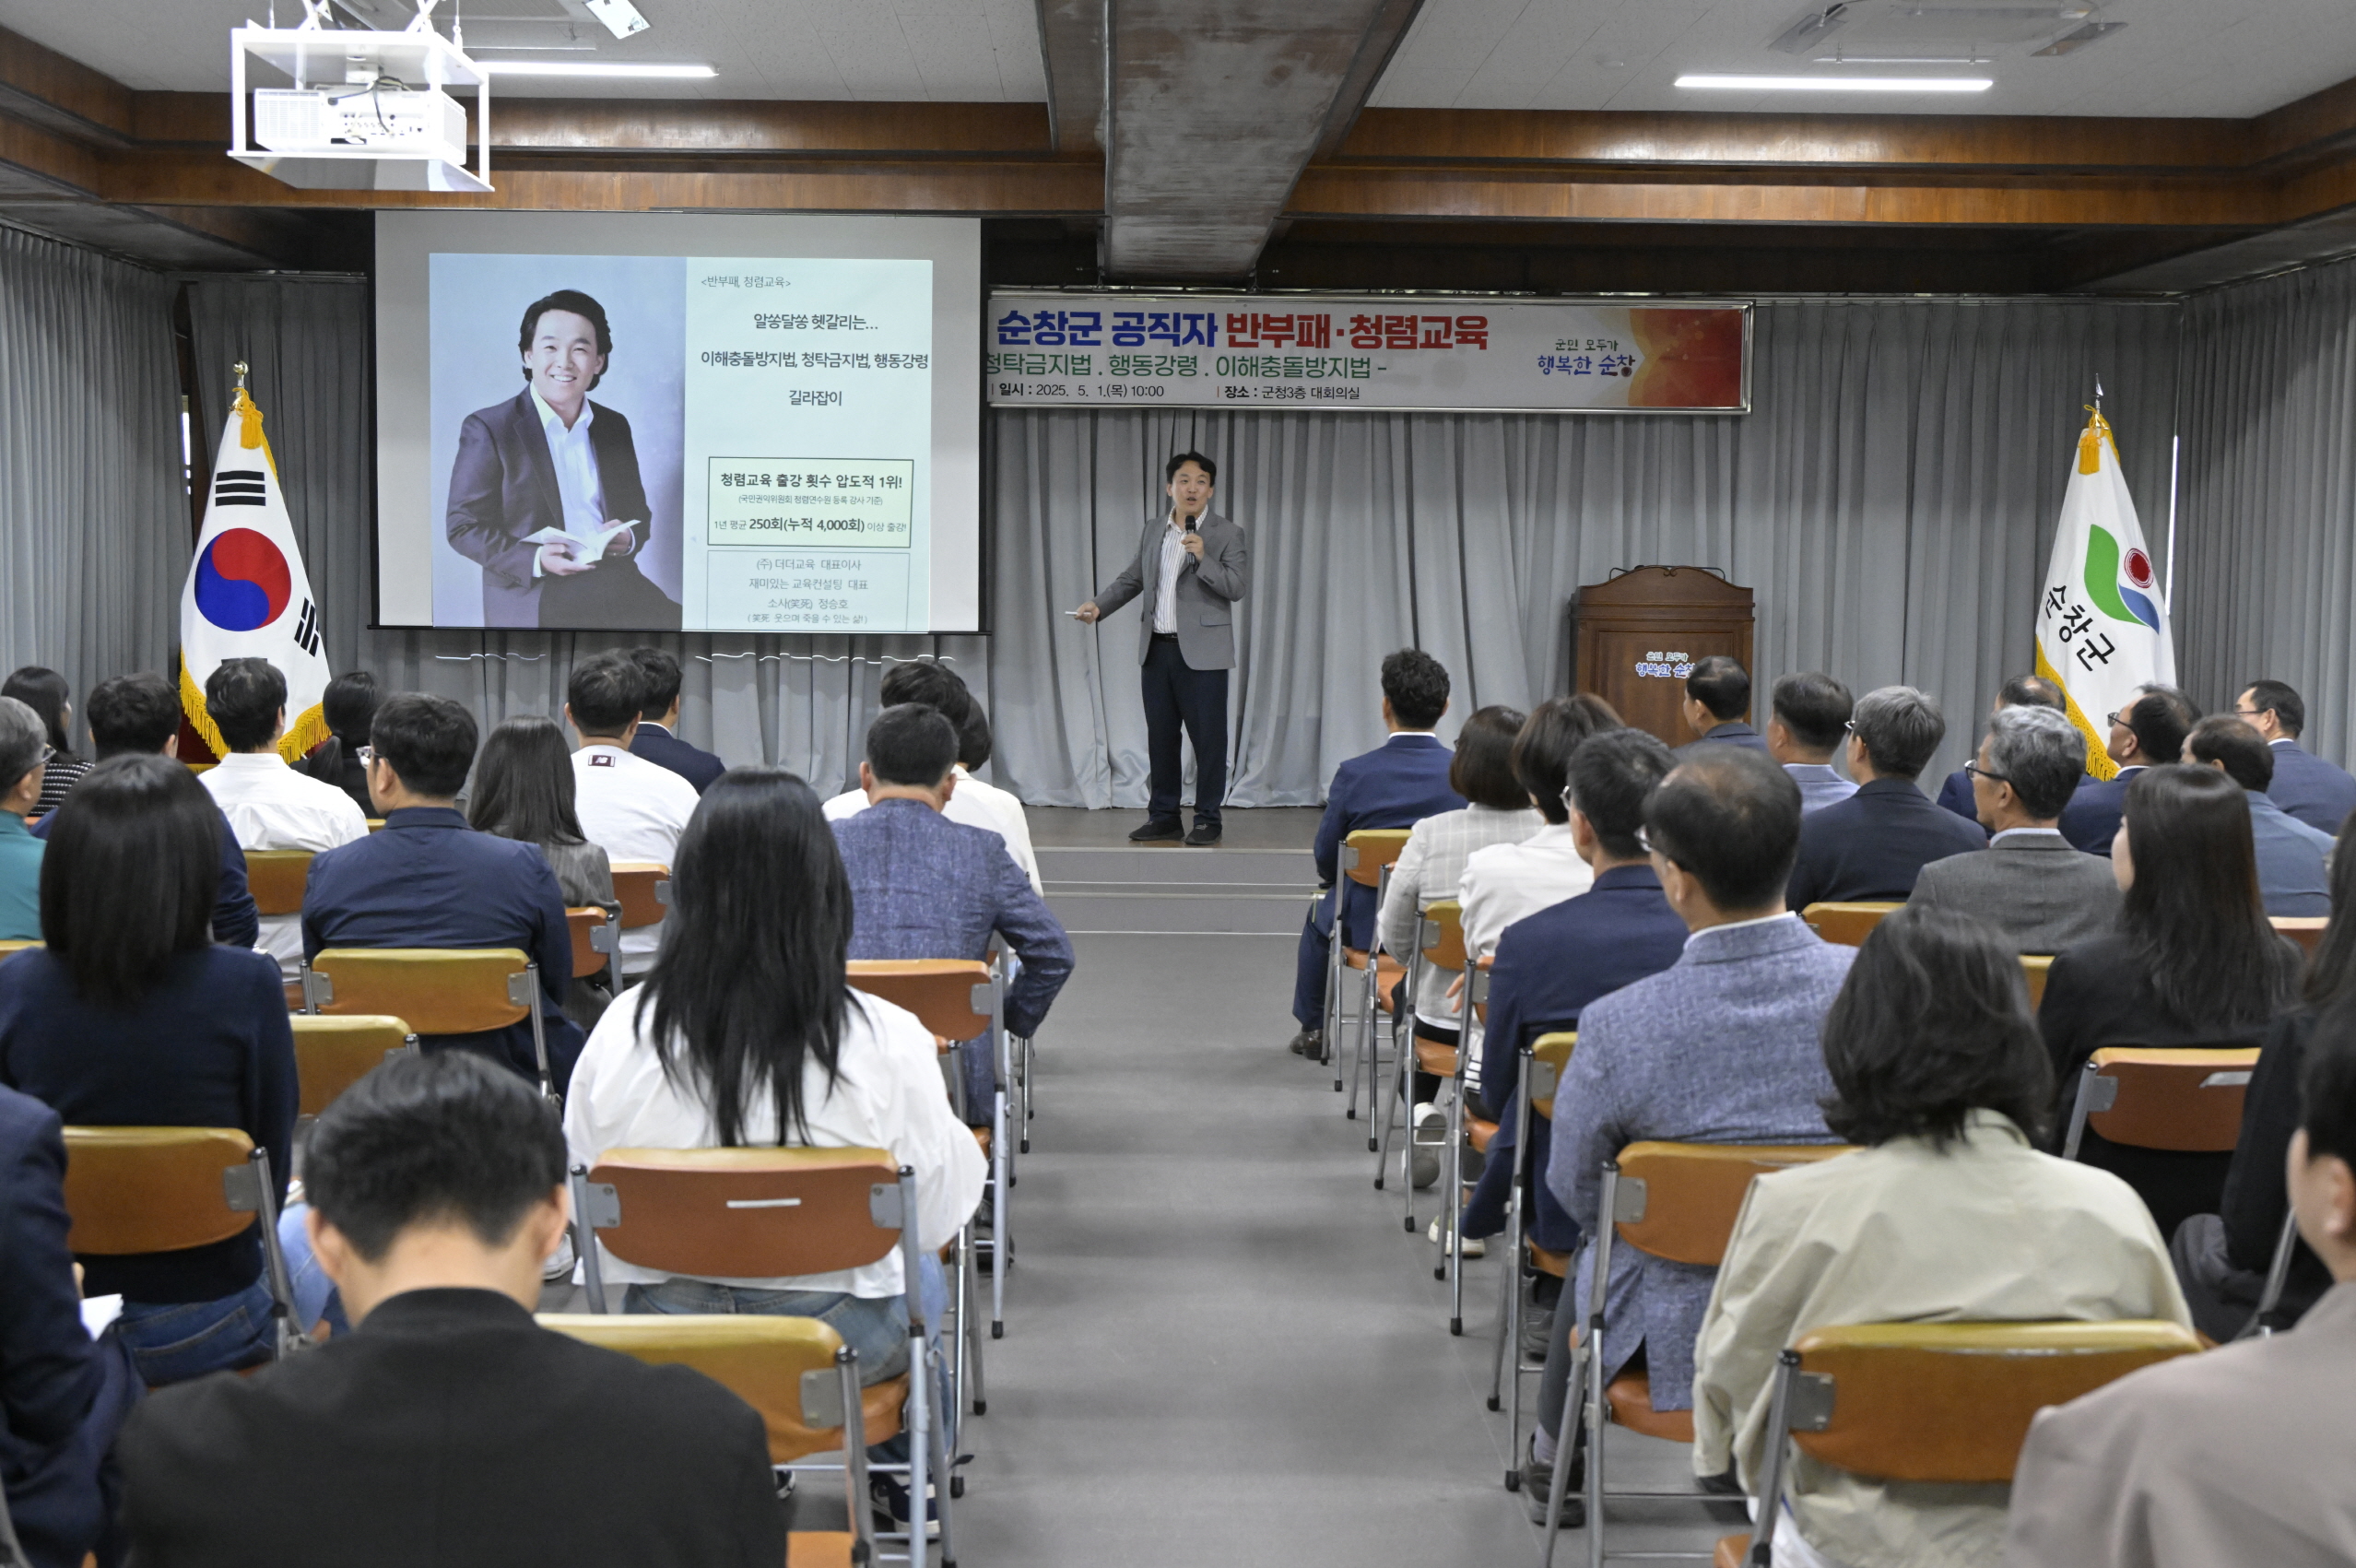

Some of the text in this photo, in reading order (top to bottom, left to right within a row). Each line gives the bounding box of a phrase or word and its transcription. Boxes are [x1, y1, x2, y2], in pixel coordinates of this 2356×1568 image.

[754, 313, 809, 329] 알쏭달쏭
[997, 310, 1489, 350] 순창군 공직자 반부패·청렴교육
[1555, 338, 1619, 352] 군민 모두가
[701, 351, 928, 370] 이해충돌방지법, 청탁금지법, 행동강령
[1109, 354, 1197, 377] 행동강령
[1216, 355, 1371, 380] 이해충돌방지법
[1537, 354, 1636, 378] 행복한 순창
[789, 389, 842, 406] 길라잡이
[999, 383, 1023, 396] 일시
[1036, 383, 1069, 396] 2025.
[1078, 384, 1089, 396] 5.
[1131, 385, 1164, 396] 10:00
[1224, 385, 1250, 398] 장소
[1261, 385, 1307, 399] 군청3층
[1311, 386, 1361, 400] 대회의실
[721, 473, 902, 489] 청렴교육 출강 횟수 압도적 1위!
[730, 520, 748, 531] 평균
[749, 517, 813, 533] 250회(누적
[817, 518, 865, 533] 4,000회)
[866, 522, 885, 533] 이상
[757, 559, 772, 571] (주)
[820, 559, 862, 571] 대표이사
[748, 578, 868, 590] 재미있는 교육컨설팅 대표
[819, 599, 849, 610] 정승호
[833, 614, 850, 624] 있는
[2045, 584, 2115, 672] 순창군
[1635, 662, 1671, 677] 행복한
